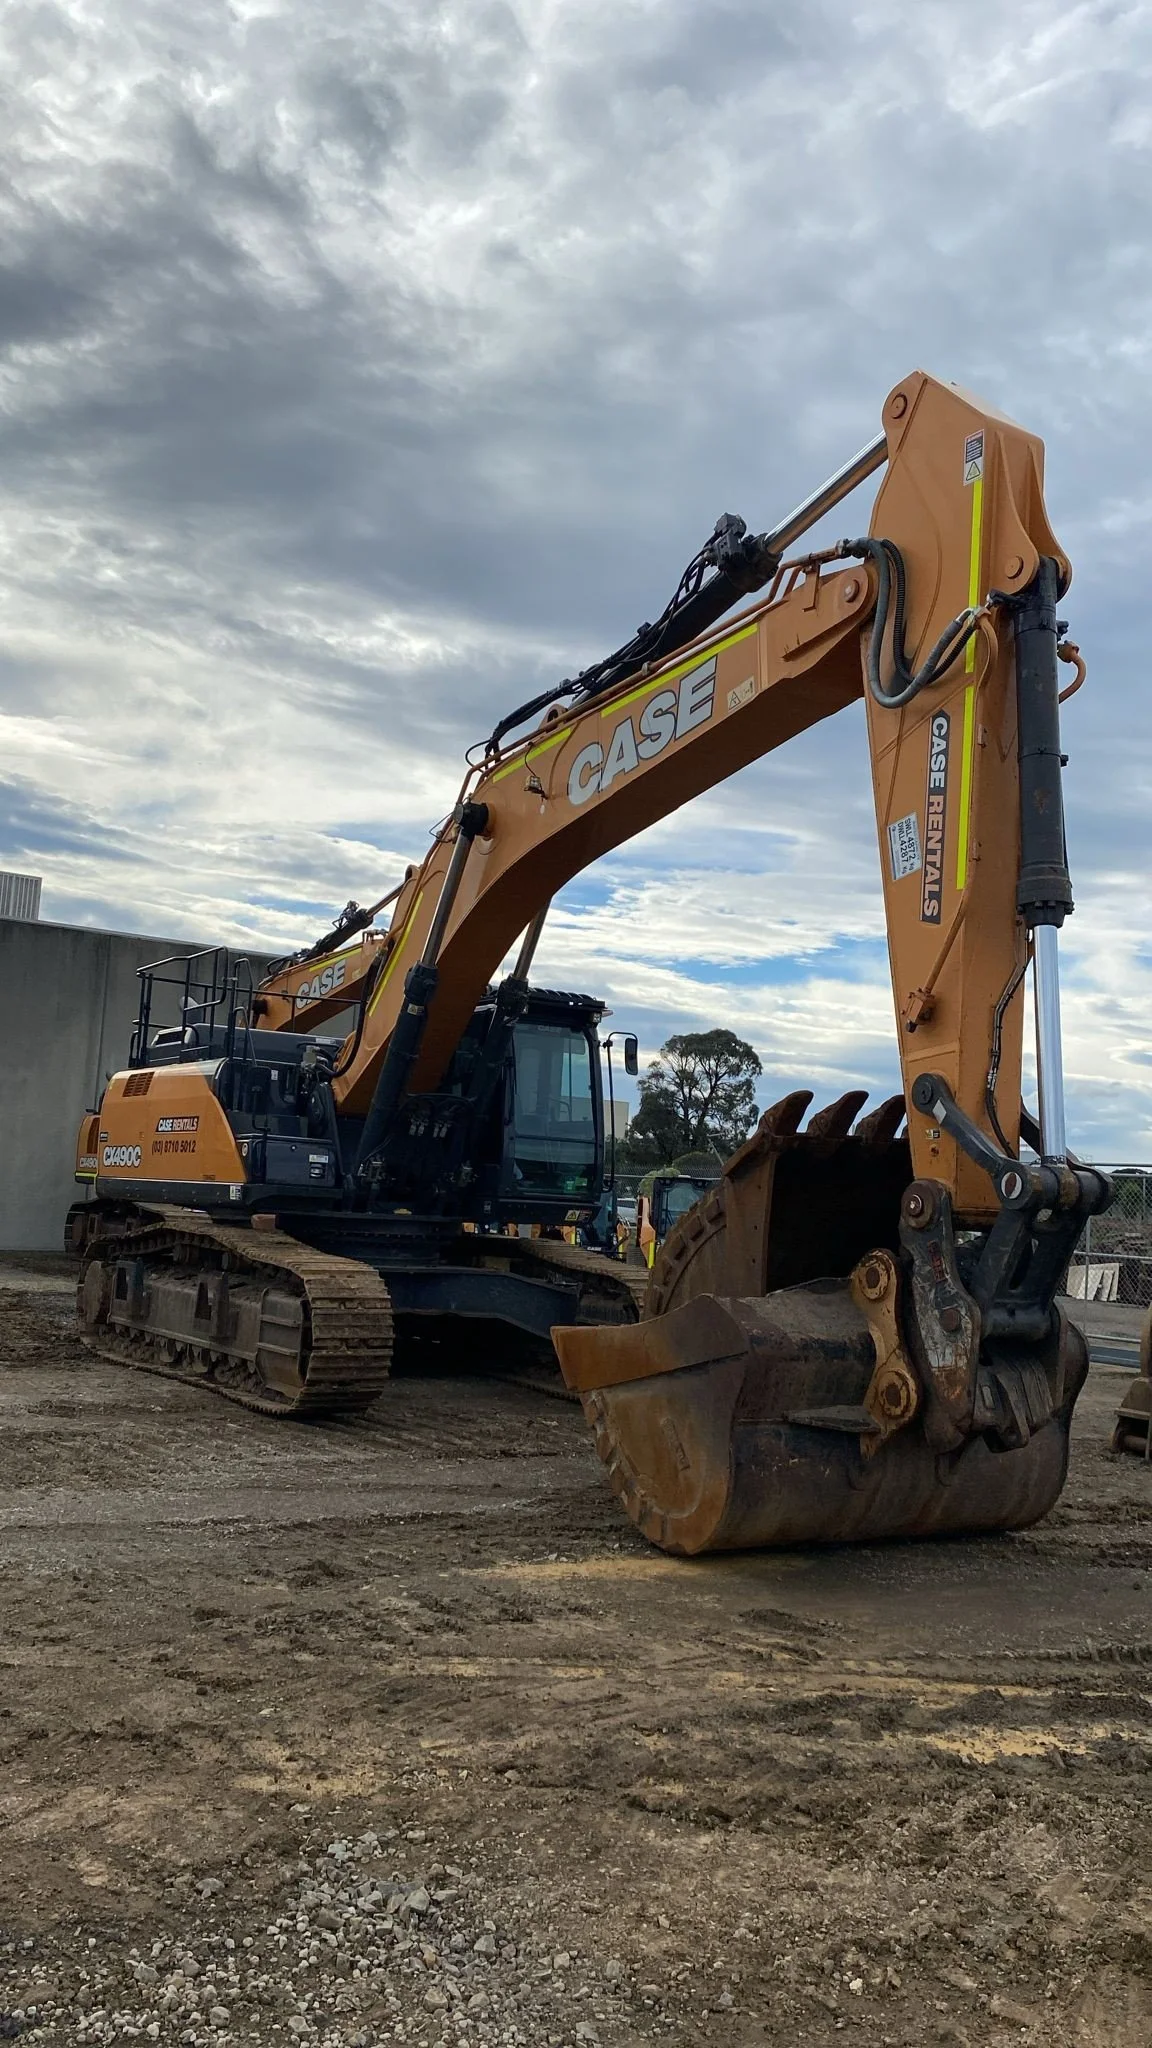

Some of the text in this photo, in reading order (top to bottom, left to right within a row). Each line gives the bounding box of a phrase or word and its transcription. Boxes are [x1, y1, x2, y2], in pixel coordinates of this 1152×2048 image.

[567, 655, 718, 805] CASE
[924, 716, 947, 917] CASE RENTALS
[900, 840, 909, 863] 4287
[907, 837, 916, 861] 4872
[296, 959, 346, 1009] CASE
[158, 1118, 198, 1132] CASE RENTALS
[103, 1145, 142, 1168] CX490C
[180, 1140, 197, 1153] 5012
